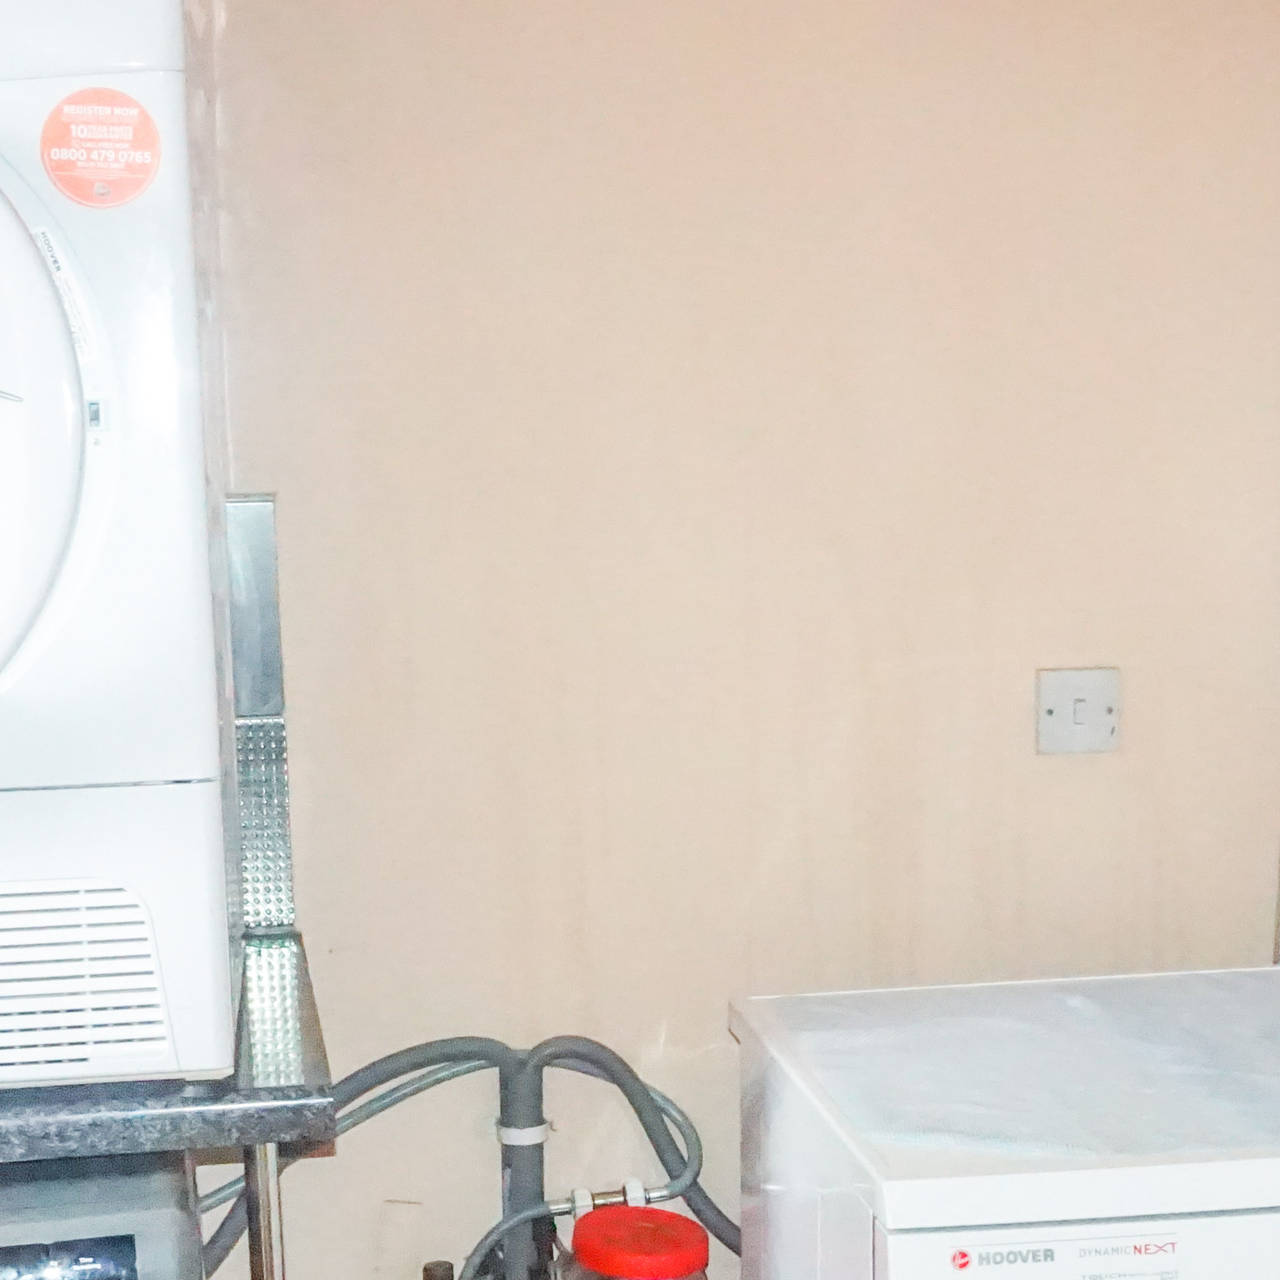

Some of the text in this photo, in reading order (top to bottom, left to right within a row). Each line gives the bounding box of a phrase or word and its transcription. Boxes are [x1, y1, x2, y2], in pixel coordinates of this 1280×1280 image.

[70, 124, 87, 139] 10
[50, 148, 152, 164] 0800 479 0765
[977, 1248, 1055, 1267] HOOVER
